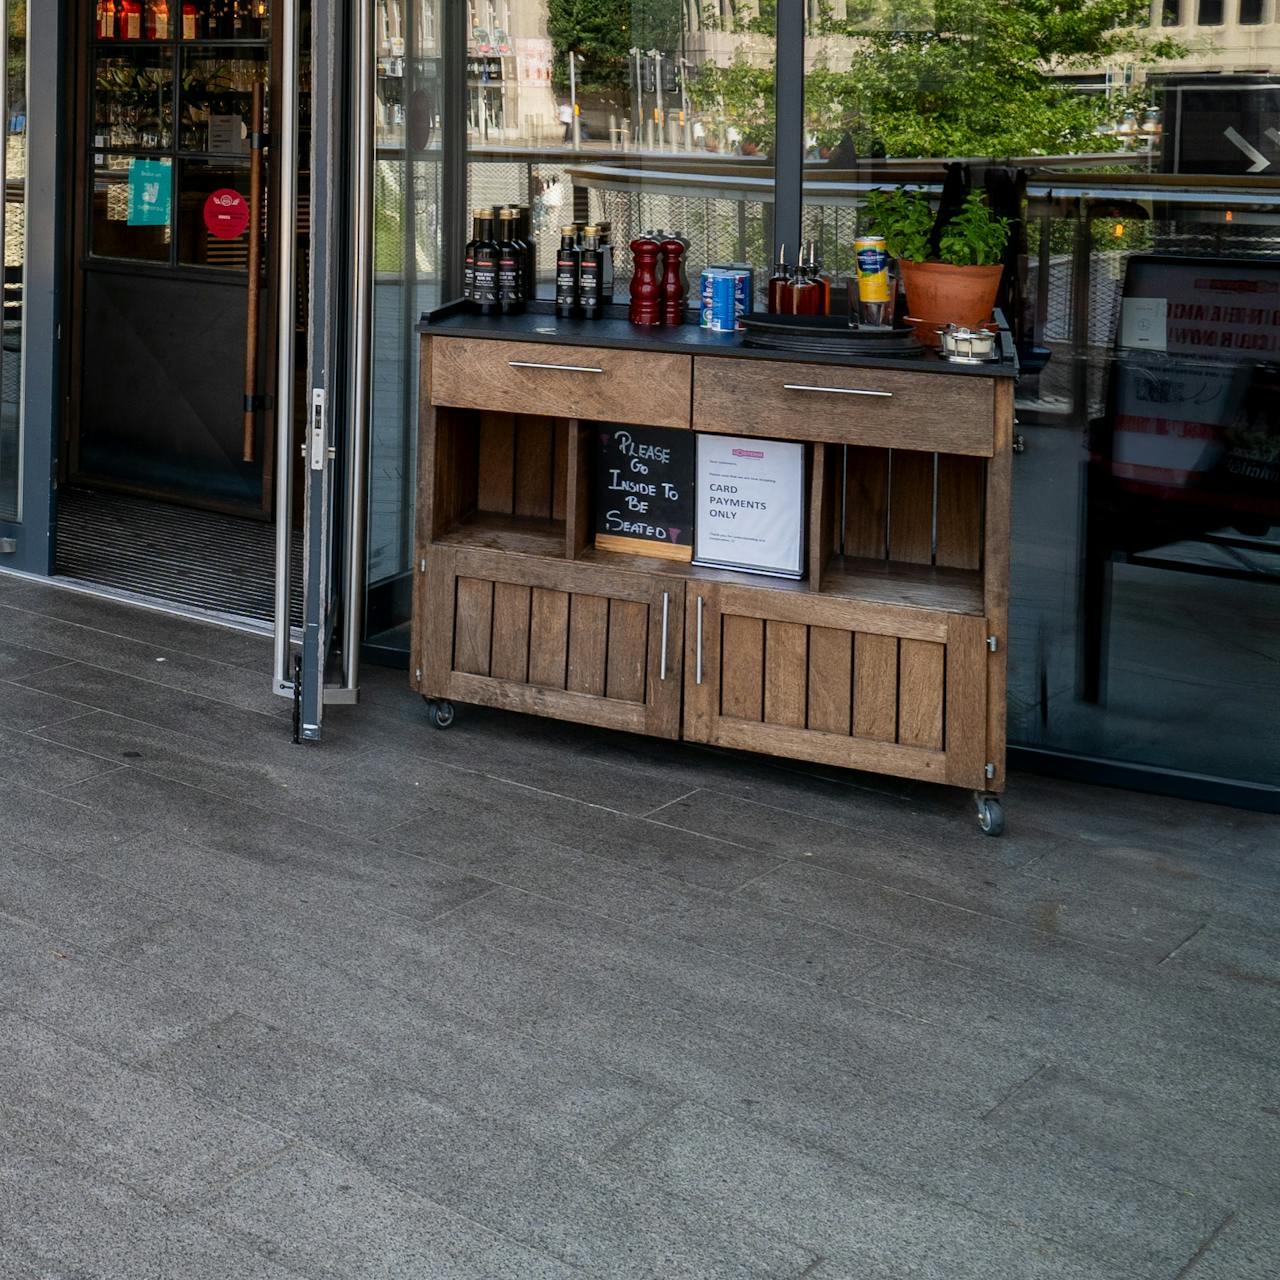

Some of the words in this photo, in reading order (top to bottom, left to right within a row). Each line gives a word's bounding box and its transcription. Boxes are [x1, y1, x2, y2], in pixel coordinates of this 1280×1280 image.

[615, 431, 670, 464] PLEASE
[608, 469, 656, 496] INSIDE
[709, 483, 738, 494] CARD
[625, 496, 648, 513] BE
[709, 496, 767, 510] PAYMENTS
[709, 509, 737, 520] ONLY
[606, 510, 666, 539] SEATED
